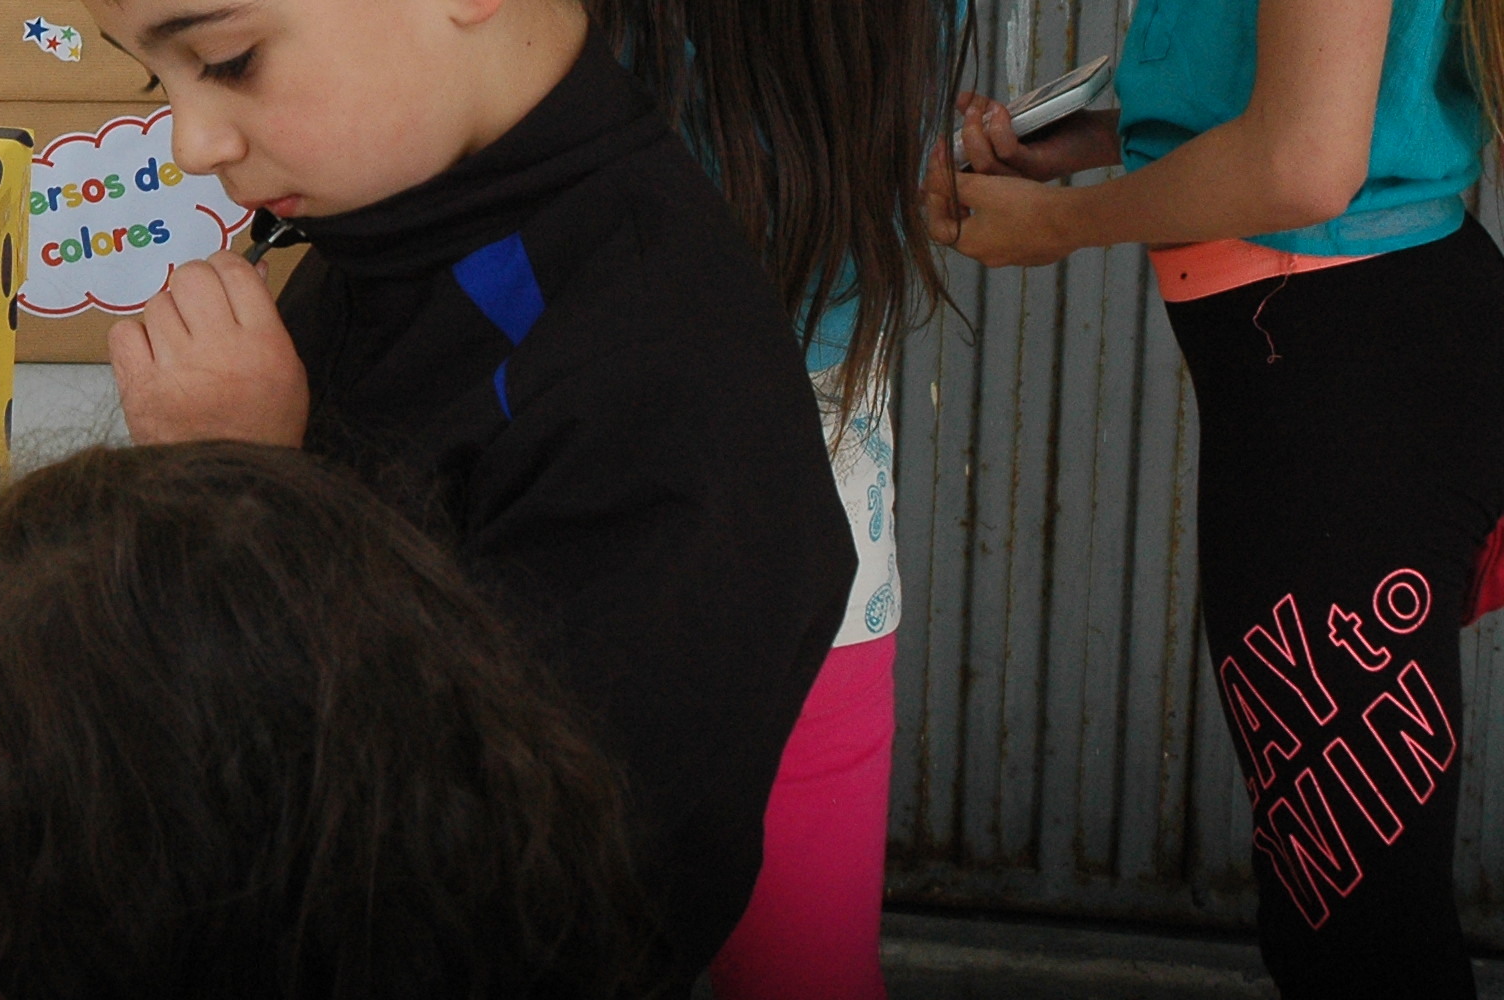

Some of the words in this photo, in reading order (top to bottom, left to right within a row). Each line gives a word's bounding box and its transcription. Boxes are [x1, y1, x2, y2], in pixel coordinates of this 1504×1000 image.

[41, 219, 171, 266] colores
[135, 157, 184, 192] de
[1220, 593, 1338, 808] AY
[1327, 568, 1431, 671] to
[1253, 660, 1456, 930] WIN
